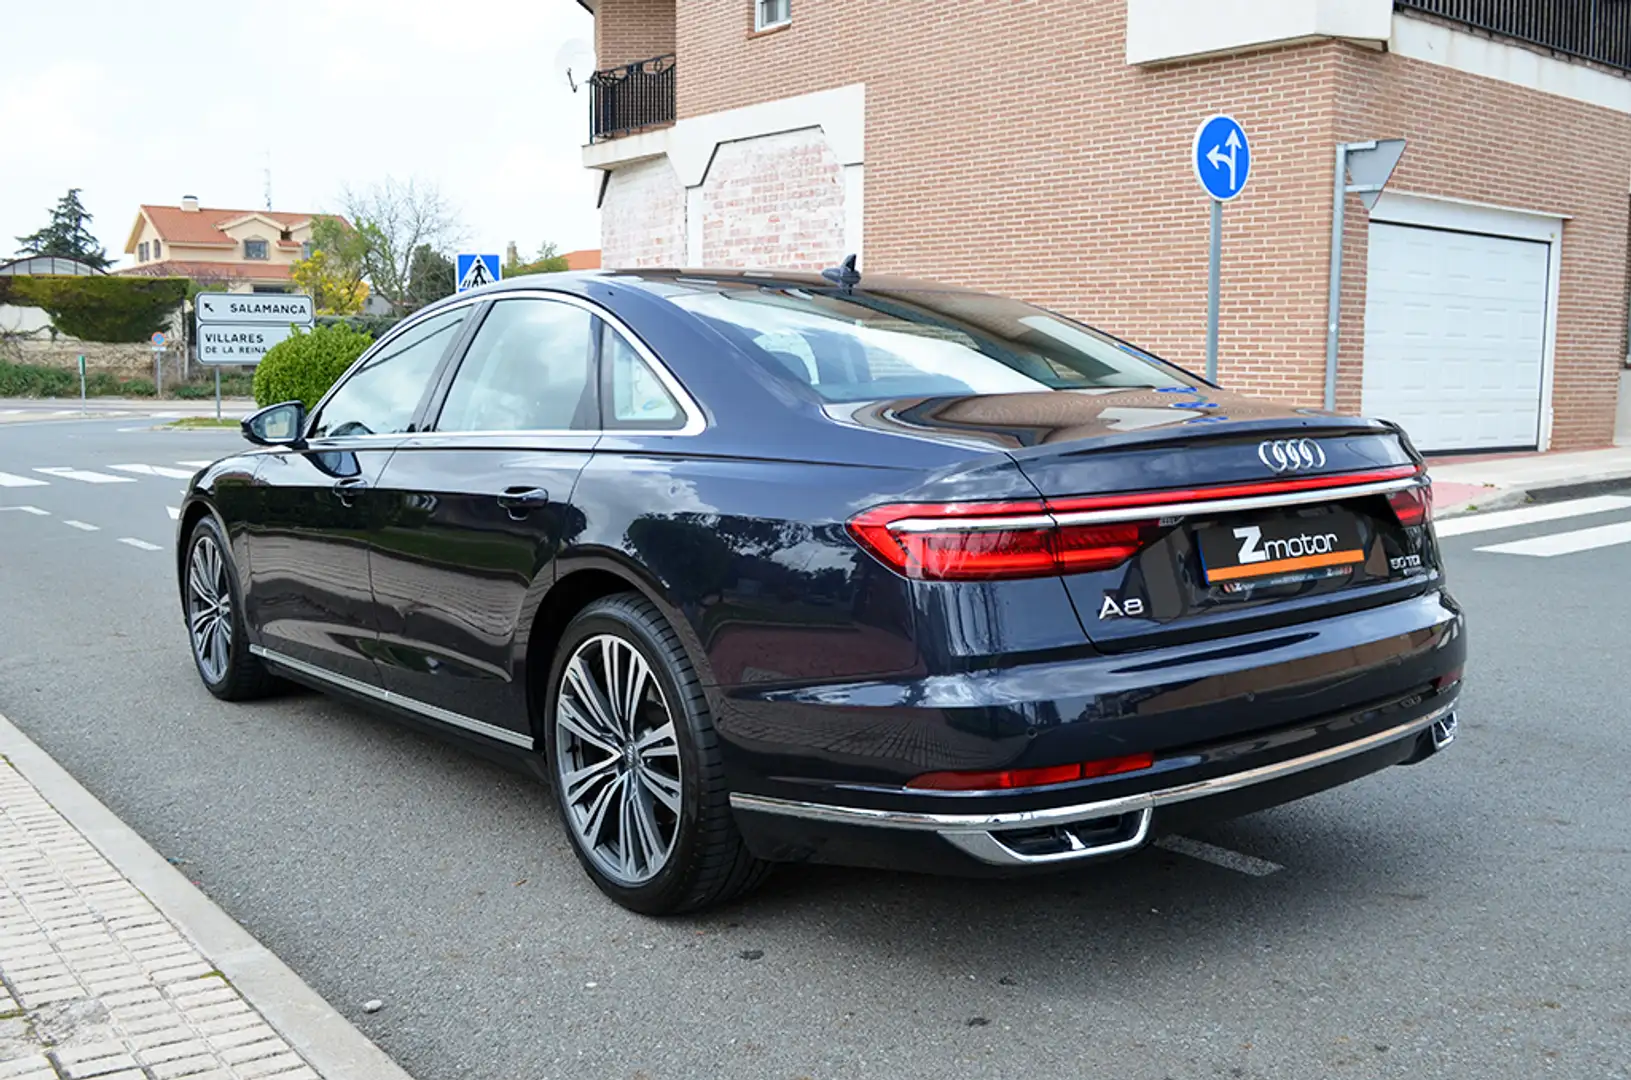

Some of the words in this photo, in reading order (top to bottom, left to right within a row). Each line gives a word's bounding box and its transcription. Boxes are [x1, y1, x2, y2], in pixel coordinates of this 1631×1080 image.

[230, 303, 307, 314] SALAMANCA
[205, 333, 264, 343] VILLARES
[1099, 595, 1144, 620] A8
